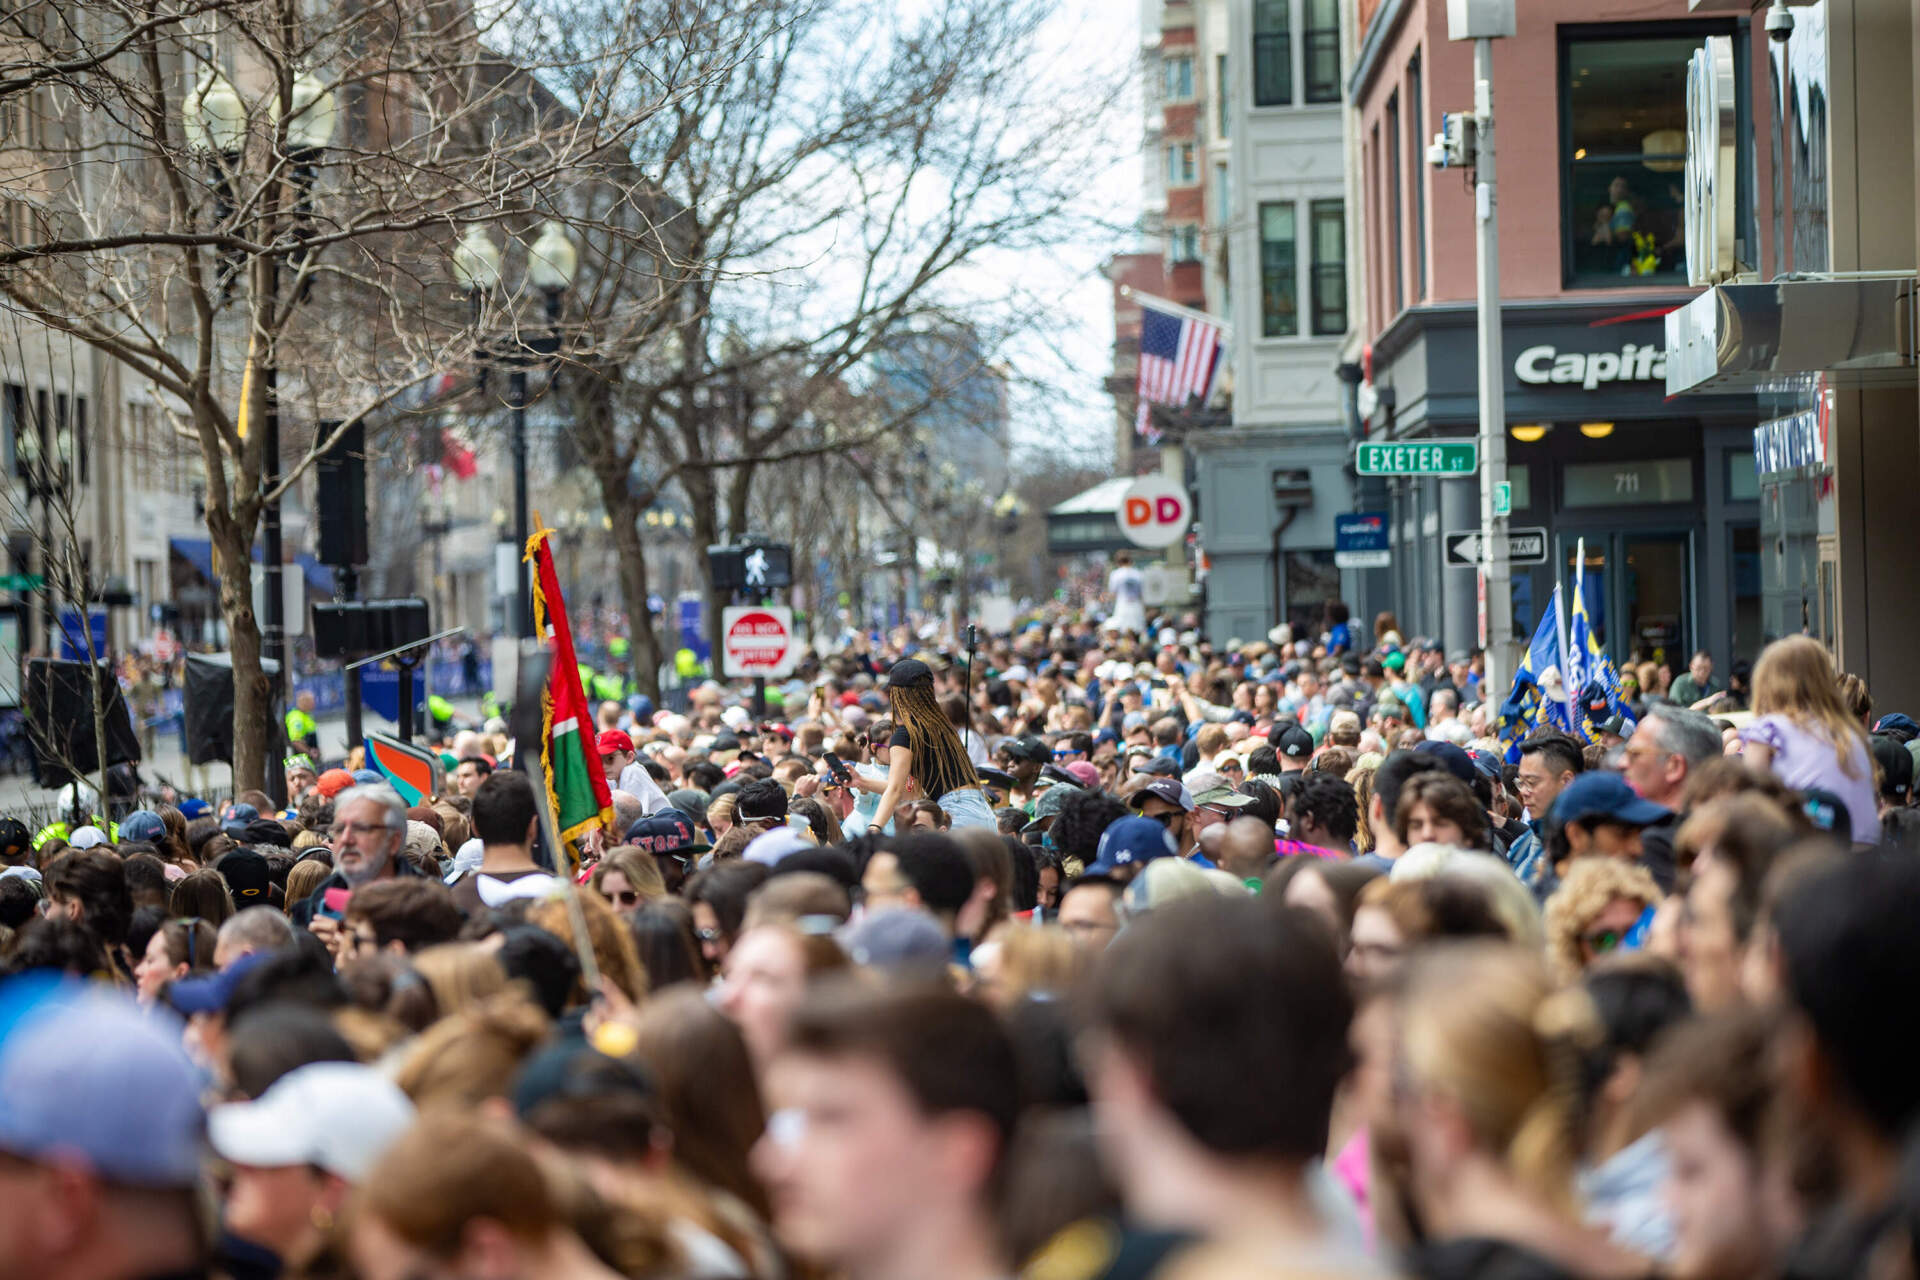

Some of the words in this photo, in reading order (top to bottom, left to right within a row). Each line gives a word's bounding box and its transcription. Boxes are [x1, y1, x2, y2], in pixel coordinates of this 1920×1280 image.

[1369, 447, 1443, 471] EXETER
[1614, 472, 1639, 493] 711
[1126, 497, 1181, 526] DD
